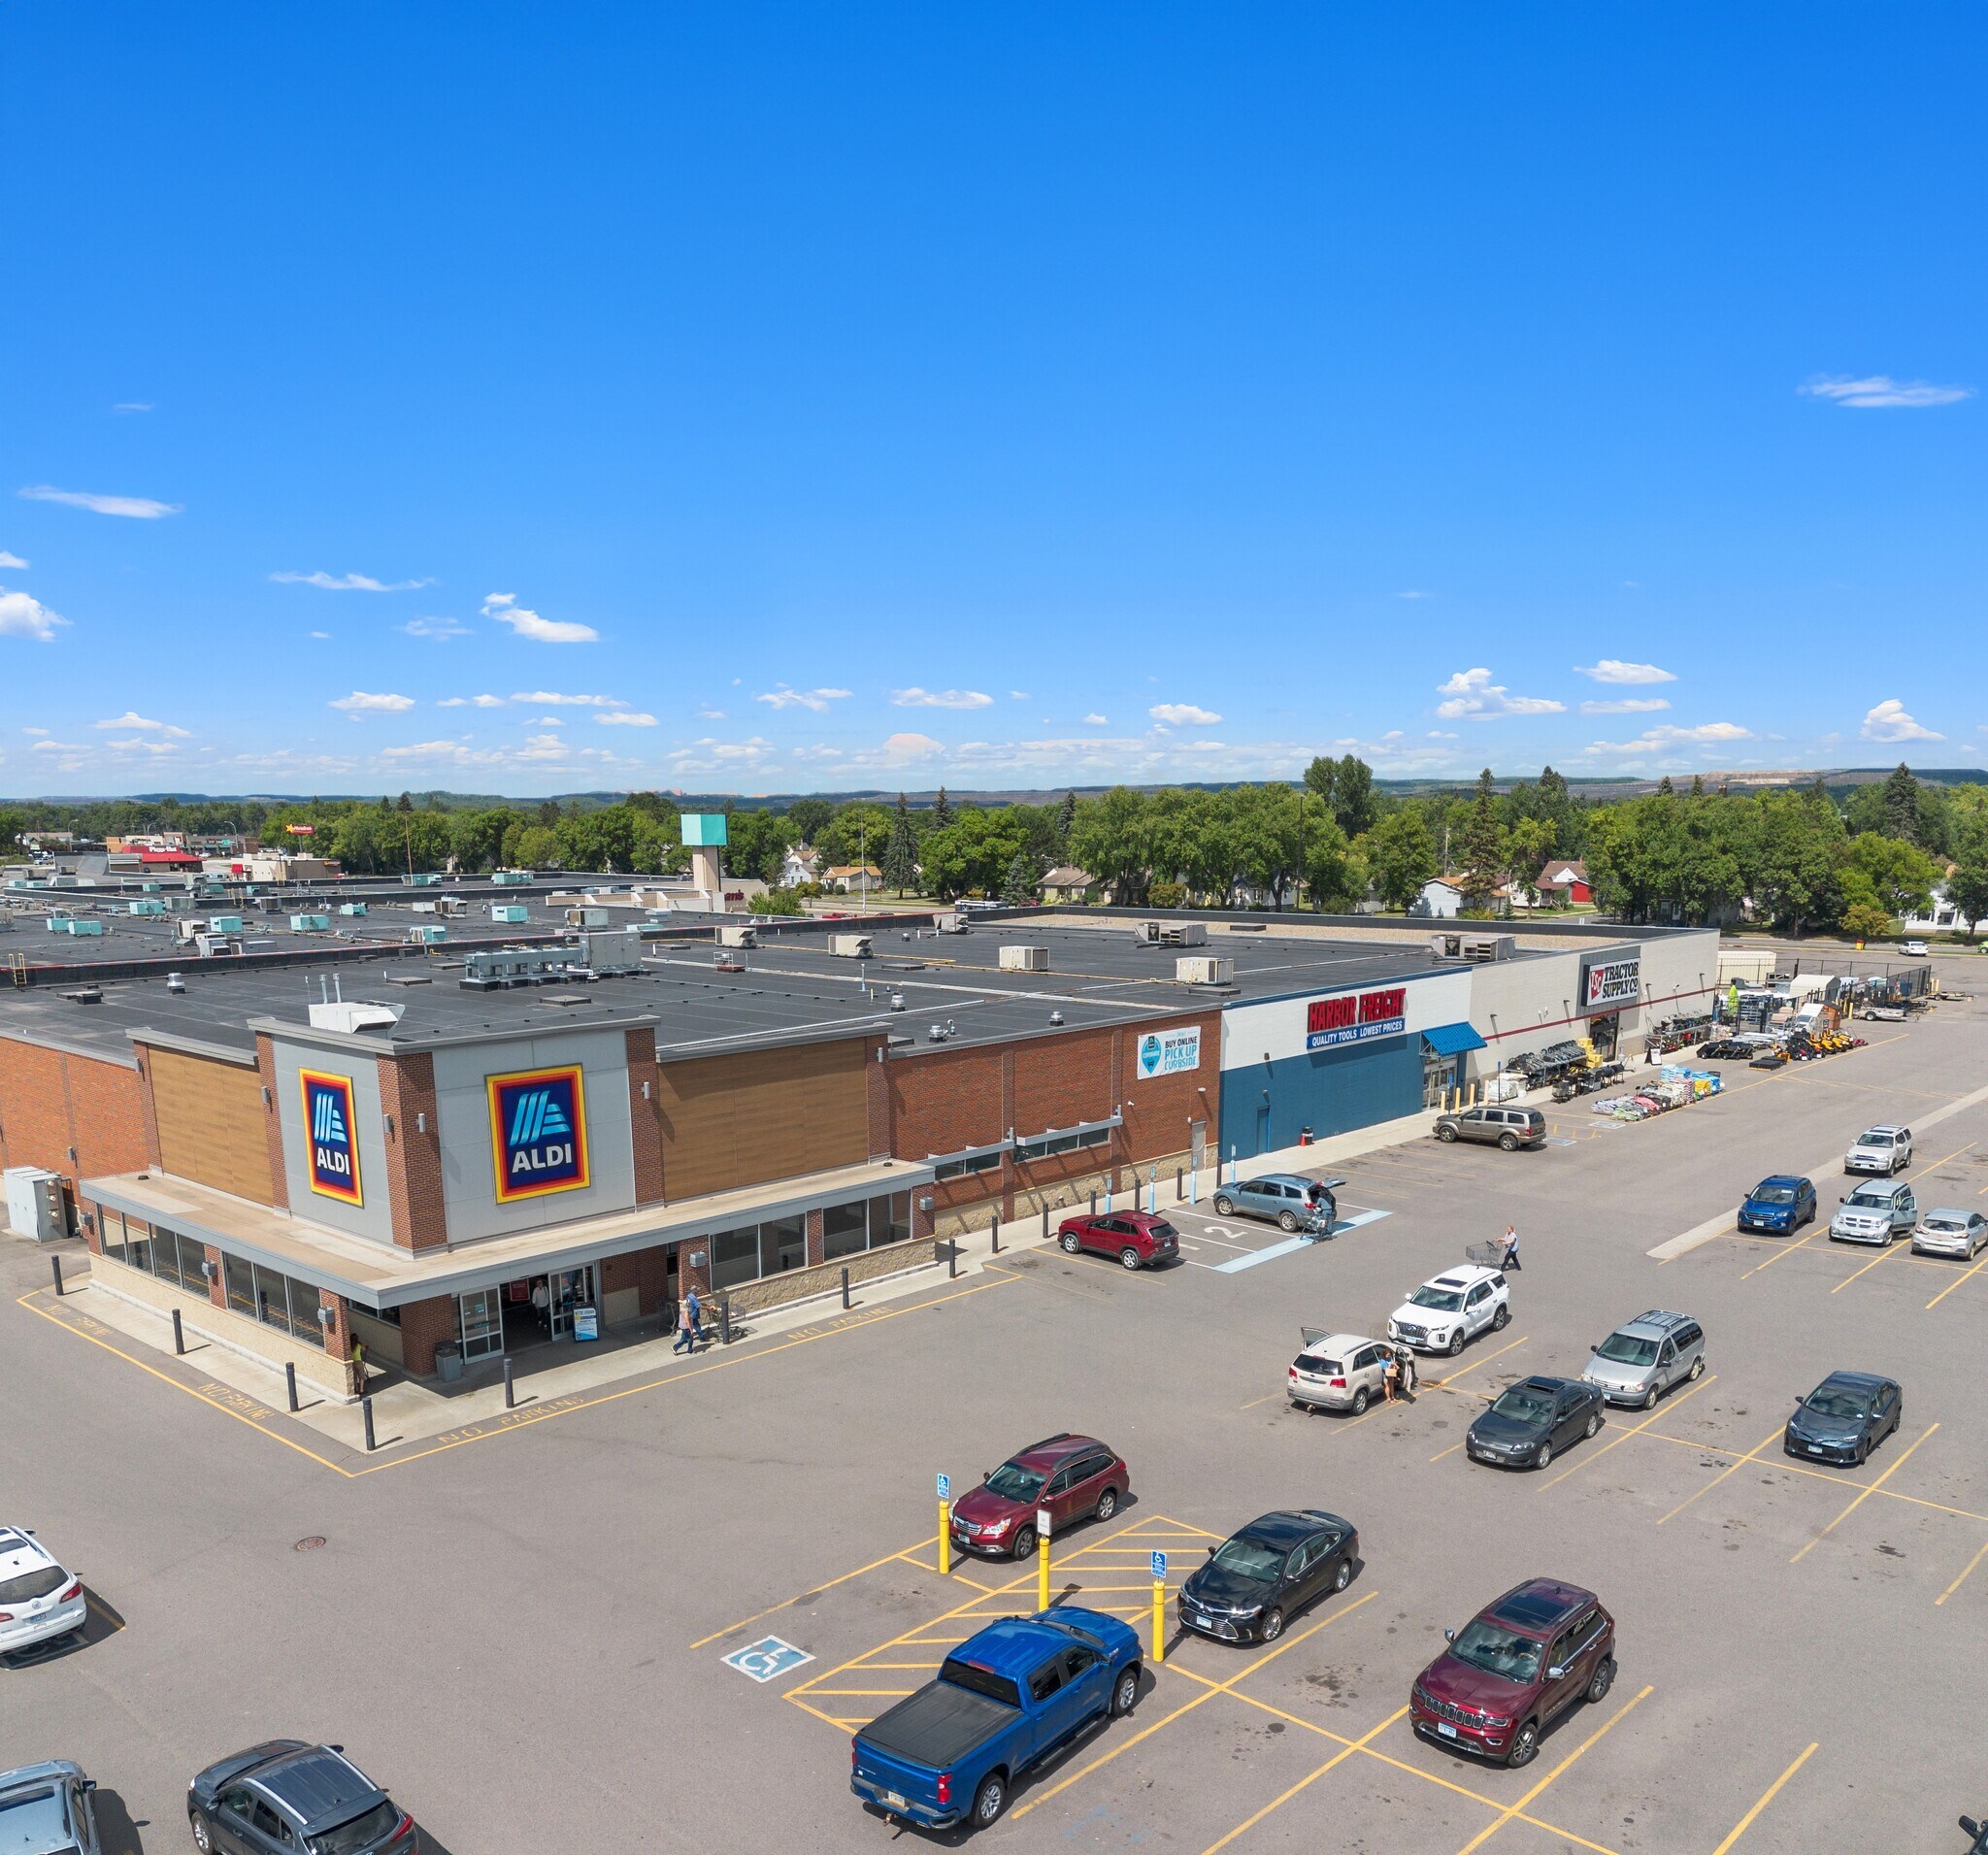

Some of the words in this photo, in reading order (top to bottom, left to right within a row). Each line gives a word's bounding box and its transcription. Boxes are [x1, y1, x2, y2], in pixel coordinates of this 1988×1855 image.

[1605, 962, 1639, 981] TRACTOR
[1592, 972, 1602, 992] TSC
[1603, 979, 1630, 999] SUPPLY
[1308, 996, 1357, 1033] HARBOR
[1359, 988, 1406, 1023] FREIGHT
[1166, 1039, 1176, 1048] BUY
[1177, 1037, 1197, 1046] ONLINE
[1312, 1033, 1337, 1046] QUALITY
[1339, 1029, 1357, 1042] TOOLS
[1360, 1025, 1382, 1037] LOWEST
[1383, 1020, 1403, 1033] PRICES
[1165, 1047, 1183, 1060] PICK
[1186, 1045, 1197, 1057] UP
[1165, 1056, 1197, 1070] CURBSIDE
[316, 1147, 349, 1175] ALDI
[512, 1143, 573, 1173] ALDI
[1204, 1227, 1247, 1239] 2
[198, 1383, 230, 1396] NO
[218, 1394, 276, 1420] PARKING
[437, 1427, 482, 1443] NO
[497, 1397, 585, 1426] PARKING
